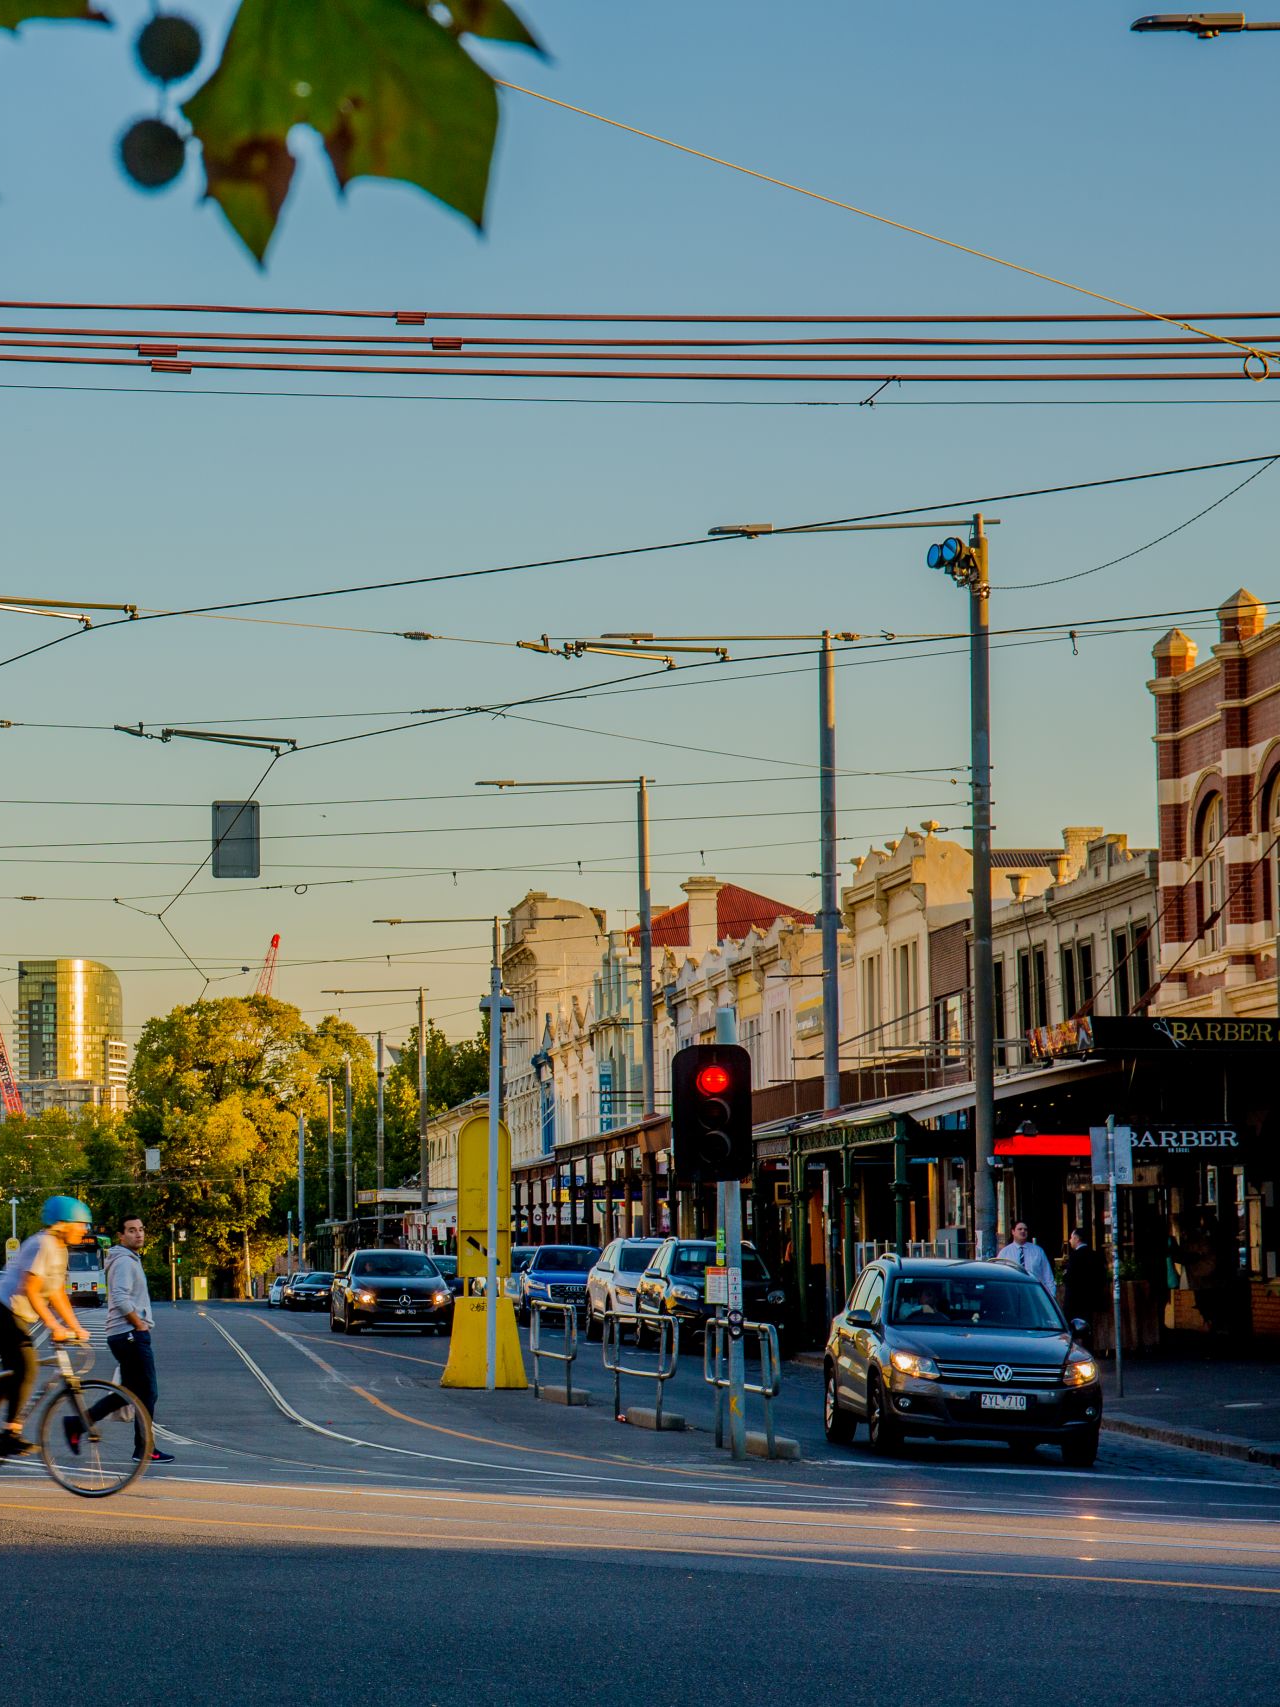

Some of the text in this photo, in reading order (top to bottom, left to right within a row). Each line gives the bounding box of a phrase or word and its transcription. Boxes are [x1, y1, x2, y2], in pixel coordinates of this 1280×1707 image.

[1171, 1022, 1273, 1042] BARBER
[982, 1394, 1025, 1407] ZYL 710
